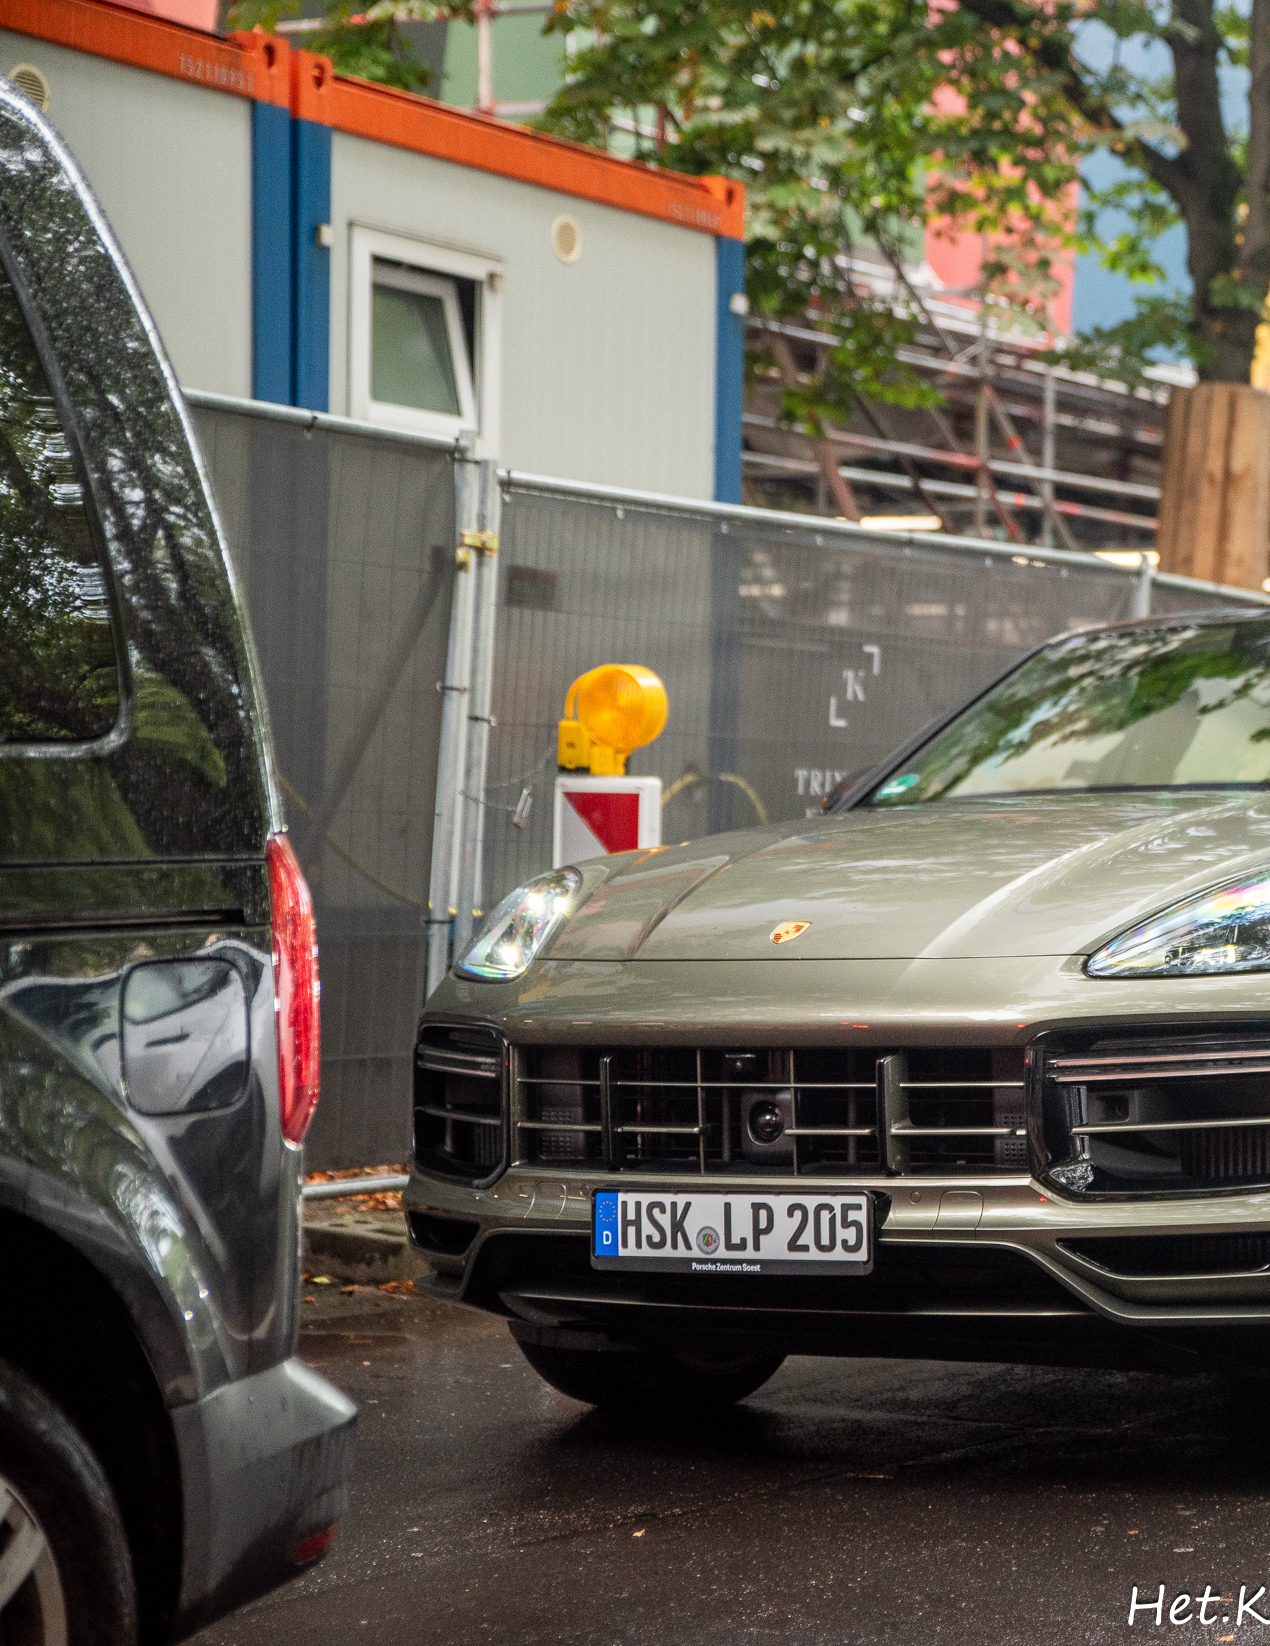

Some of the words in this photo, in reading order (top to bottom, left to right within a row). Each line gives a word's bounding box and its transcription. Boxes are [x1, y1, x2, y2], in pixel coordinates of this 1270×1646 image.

[620, 1199, 693, 1251] HSK
[723, 1201, 775, 1253] LP
[785, 1201, 865, 1254] 205
[602, 1230, 613, 1246] D
[691, 1262, 716, 1271] Porsche
[716, 1262, 742, 1272] Zentrum
[742, 1263, 761, 1272] Soest
